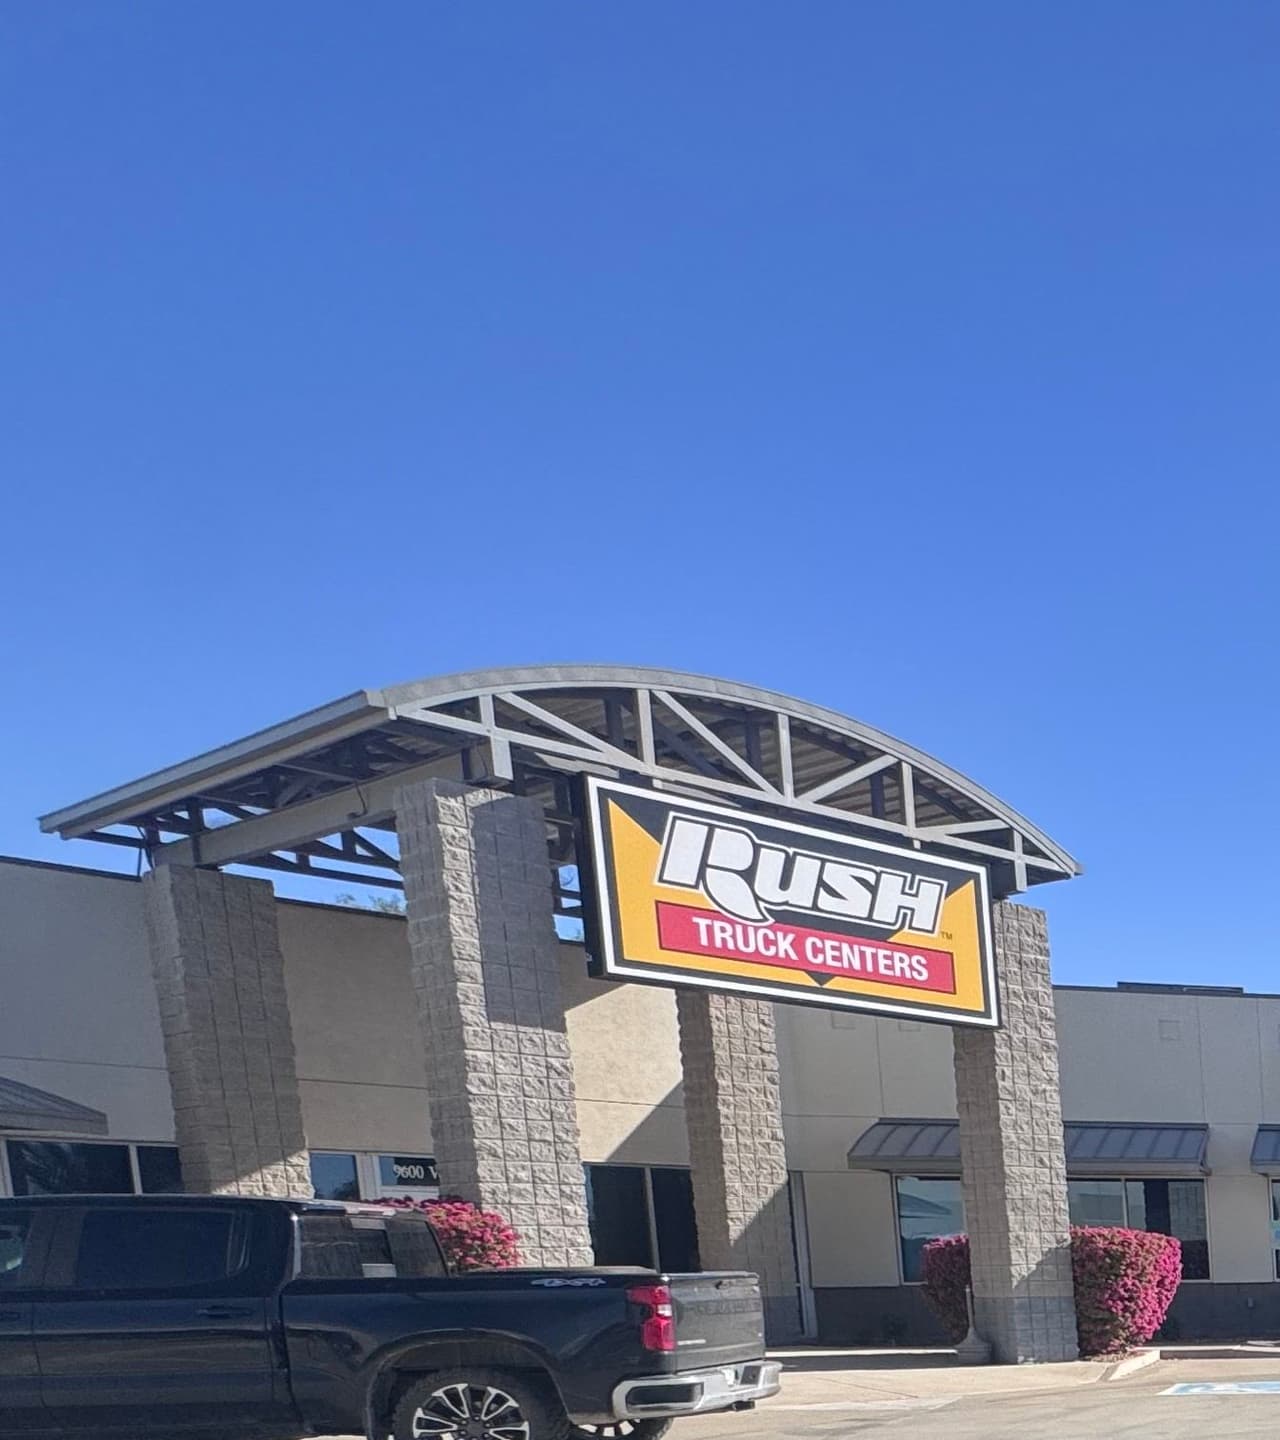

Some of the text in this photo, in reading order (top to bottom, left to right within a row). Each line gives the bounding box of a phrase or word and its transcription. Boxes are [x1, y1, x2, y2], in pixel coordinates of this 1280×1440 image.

[657, 812, 946, 933] RUSH
[692, 916, 929, 982] TRUCK CENTERS
[393, 1165, 424, 1179] 9600
